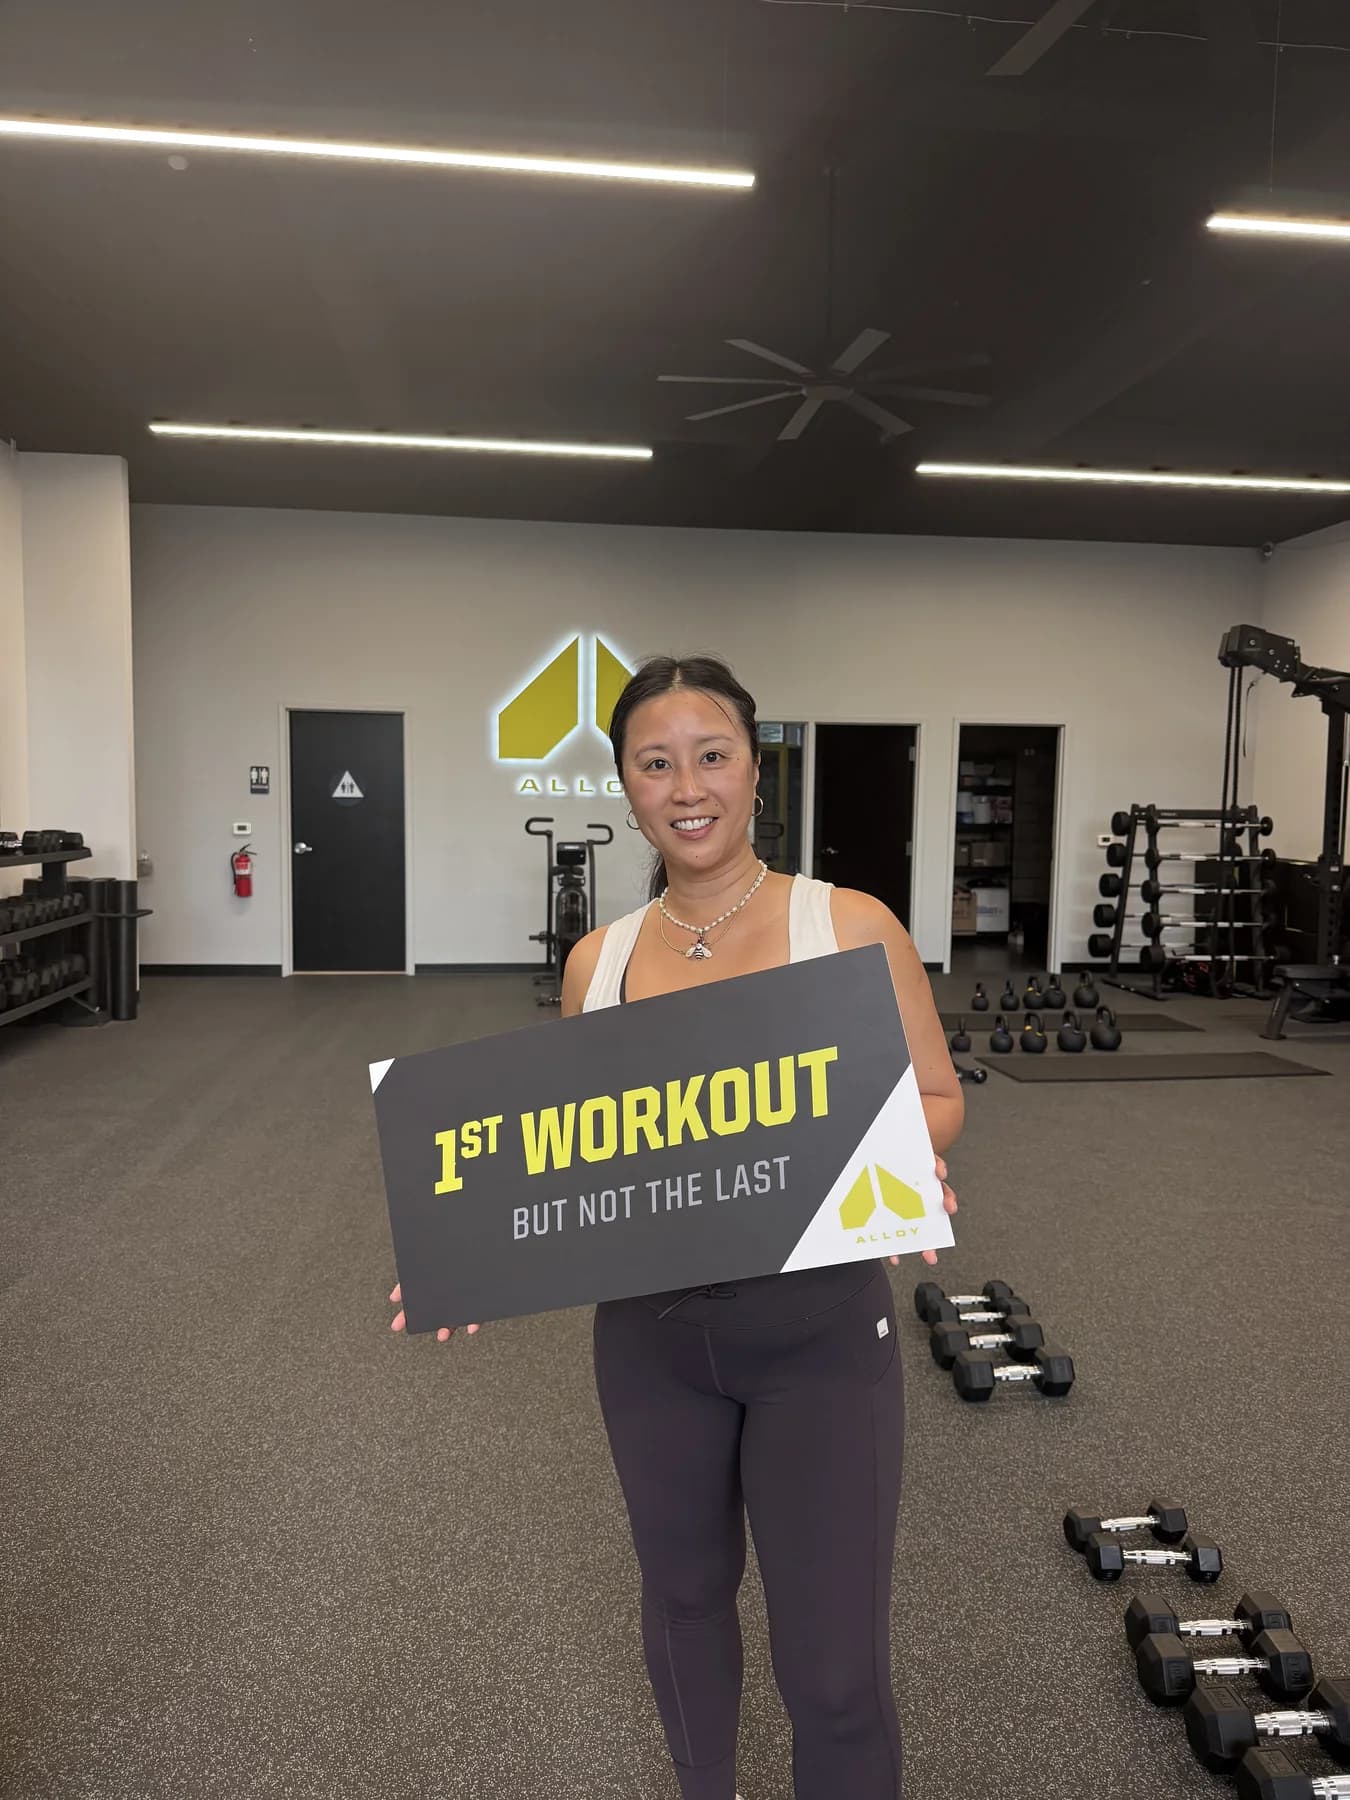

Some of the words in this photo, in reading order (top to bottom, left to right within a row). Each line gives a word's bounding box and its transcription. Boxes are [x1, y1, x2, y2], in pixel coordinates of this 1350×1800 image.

[519, 778, 625, 793] ALLO
[434, 1115, 503, 1195] 1ST
[520, 1047, 838, 1175] WORKOUT
[513, 1199, 568, 1240] BUT
[579, 1186, 636, 1227] NOT
[645, 1172, 703, 1214] THE
[715, 1156, 791, 1202] LAST
[856, 1227, 918, 1244] ALLOY
